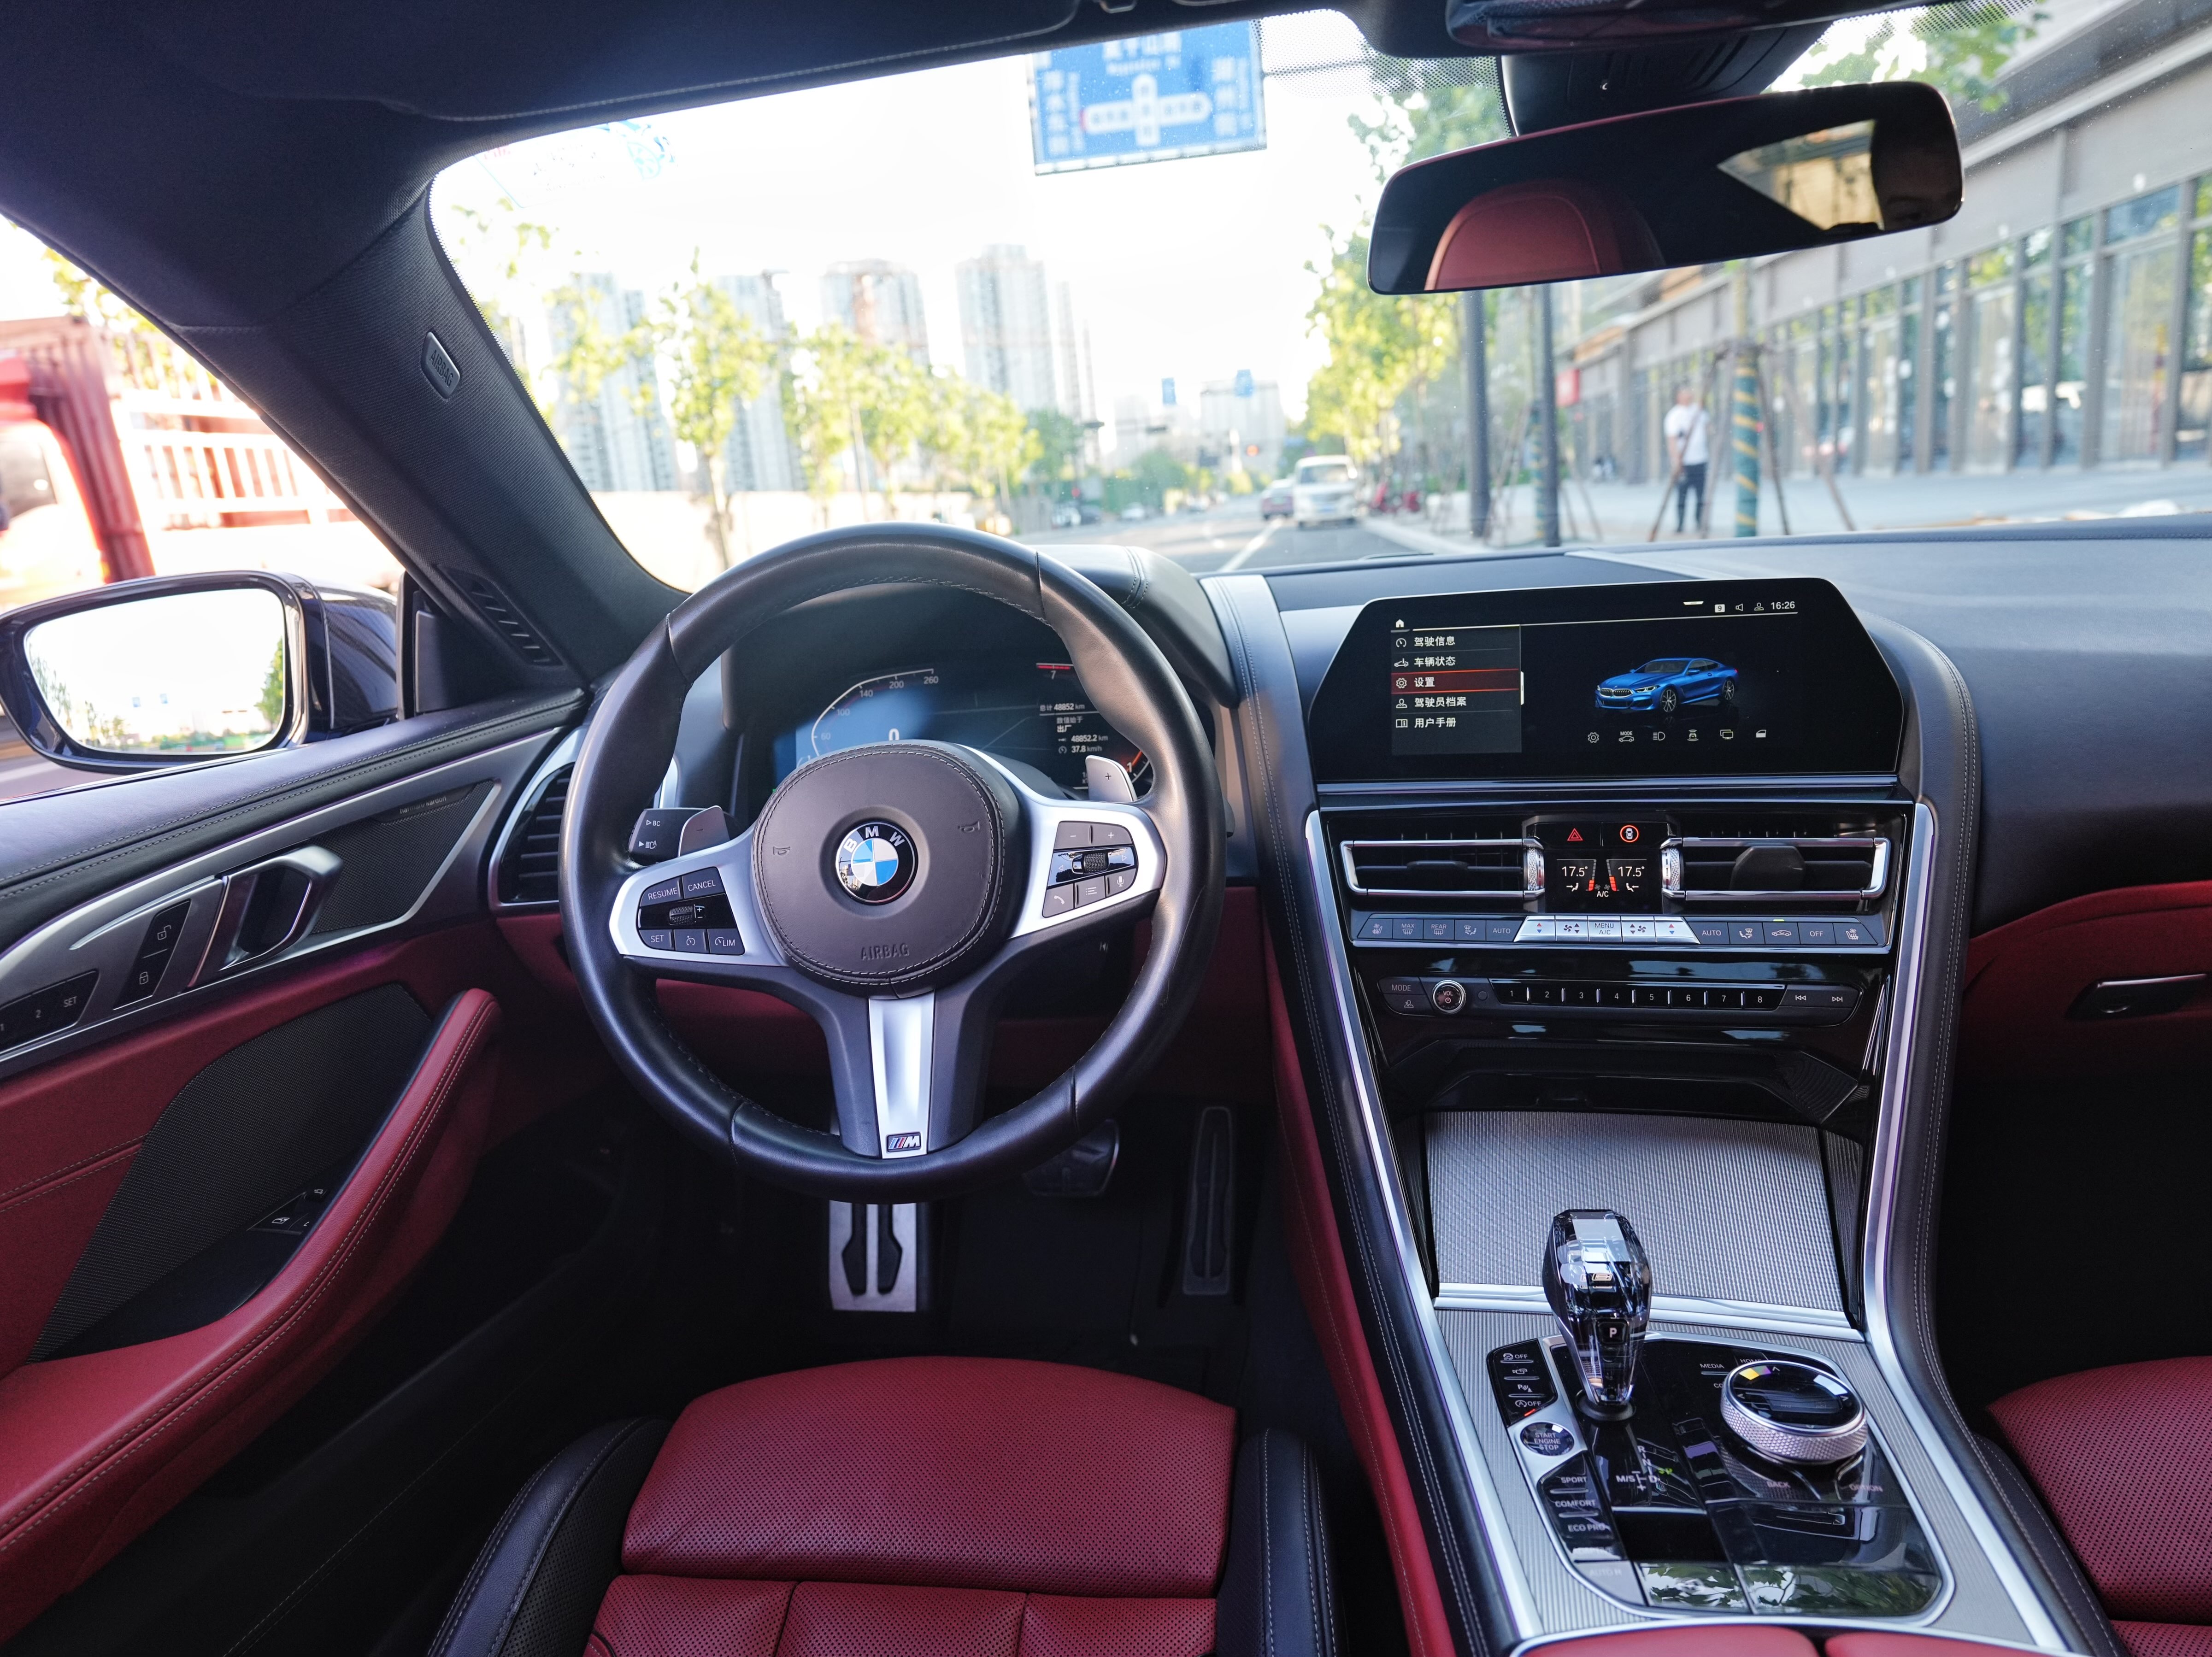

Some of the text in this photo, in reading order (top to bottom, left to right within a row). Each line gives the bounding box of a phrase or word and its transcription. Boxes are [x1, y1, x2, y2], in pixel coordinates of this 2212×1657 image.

[429, 350, 453, 388] AIRBAG
[1771, 601, 1795, 610] 16:26
[1414, 636, 1455, 646] 驾驶信息
[1414, 656, 1456, 667] 车辆状态
[1051, 670, 1056, 679] 7
[889, 681, 904, 689] 200
[924, 676, 939, 684] 260
[1414, 677, 1435, 687] 设置
[1414, 696, 1466, 708] 驾驶员档案
[1414, 717, 1456, 728] 用户手册
[1127, 762, 1132, 772] 1
[843, 825, 905, 853] BMW
[688, 880, 716, 892] CANCEL
[648, 887, 678, 900] RESUME
[860, 944, 910, 961] AIRBAG
[64, 996, 77, 1007] SET
[1609, 1328, 1617, 1338] P
[1555, 1499, 1596, 1508] COMFORT
[1568, 1523, 1606, 1532] ECO PRO
